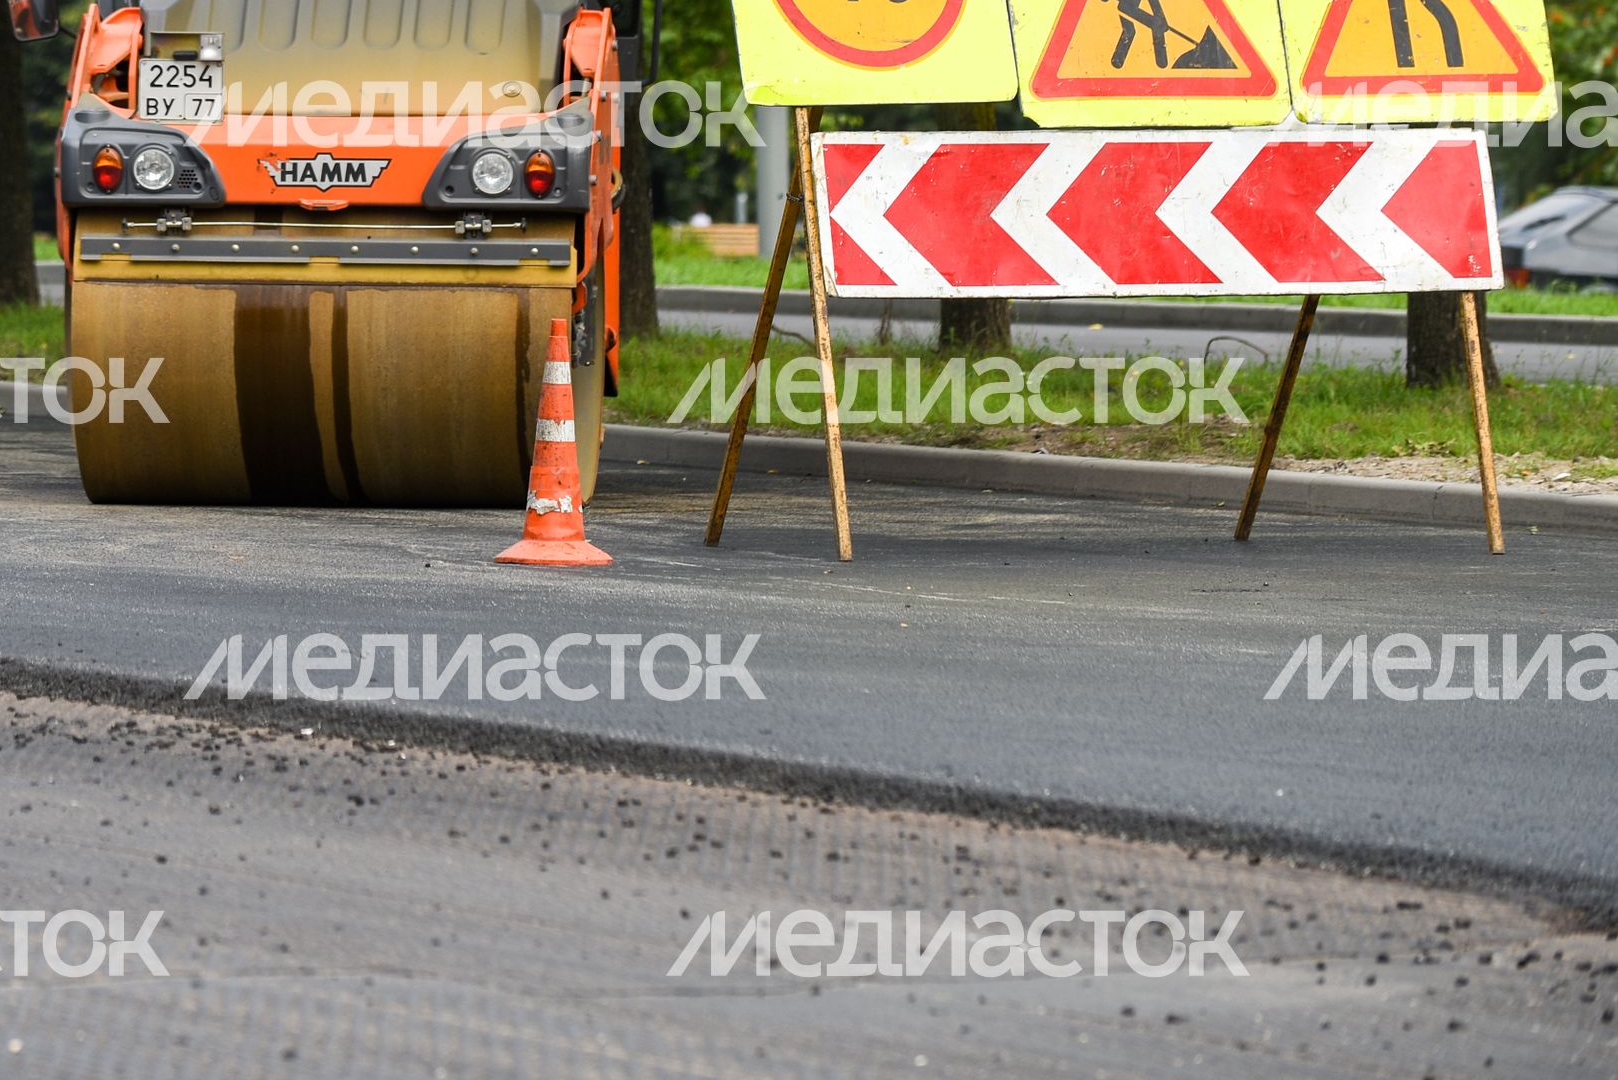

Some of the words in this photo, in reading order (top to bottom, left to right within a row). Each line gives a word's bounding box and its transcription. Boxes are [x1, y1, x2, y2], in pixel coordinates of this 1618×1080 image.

[149, 64, 213, 88] 2254
[146, 98, 175, 116] ВУ
[191, 98, 216, 116] 77
[280, 162, 367, 182] HAMM
